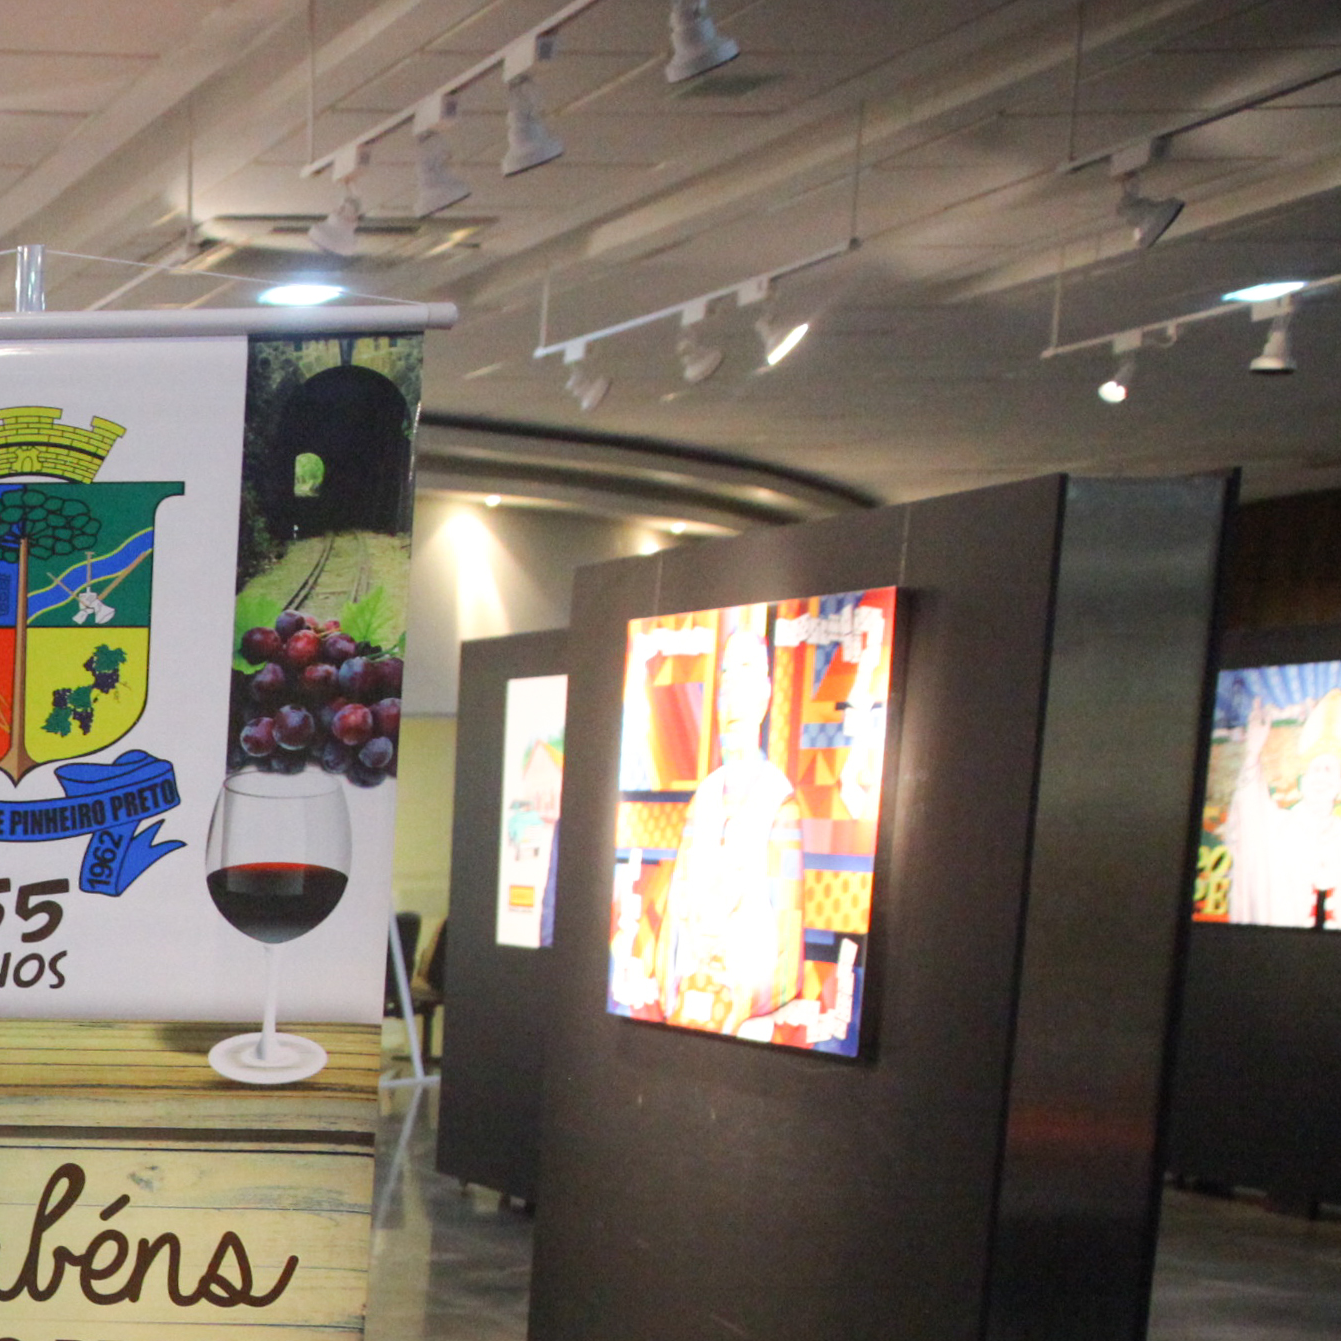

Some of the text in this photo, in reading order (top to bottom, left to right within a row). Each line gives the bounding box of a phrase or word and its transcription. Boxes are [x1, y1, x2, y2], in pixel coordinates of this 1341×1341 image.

[9, 803, 105, 836] PINHEIRO
[109, 777, 175, 819] PRETO
[87, 830, 122, 888] 1962
